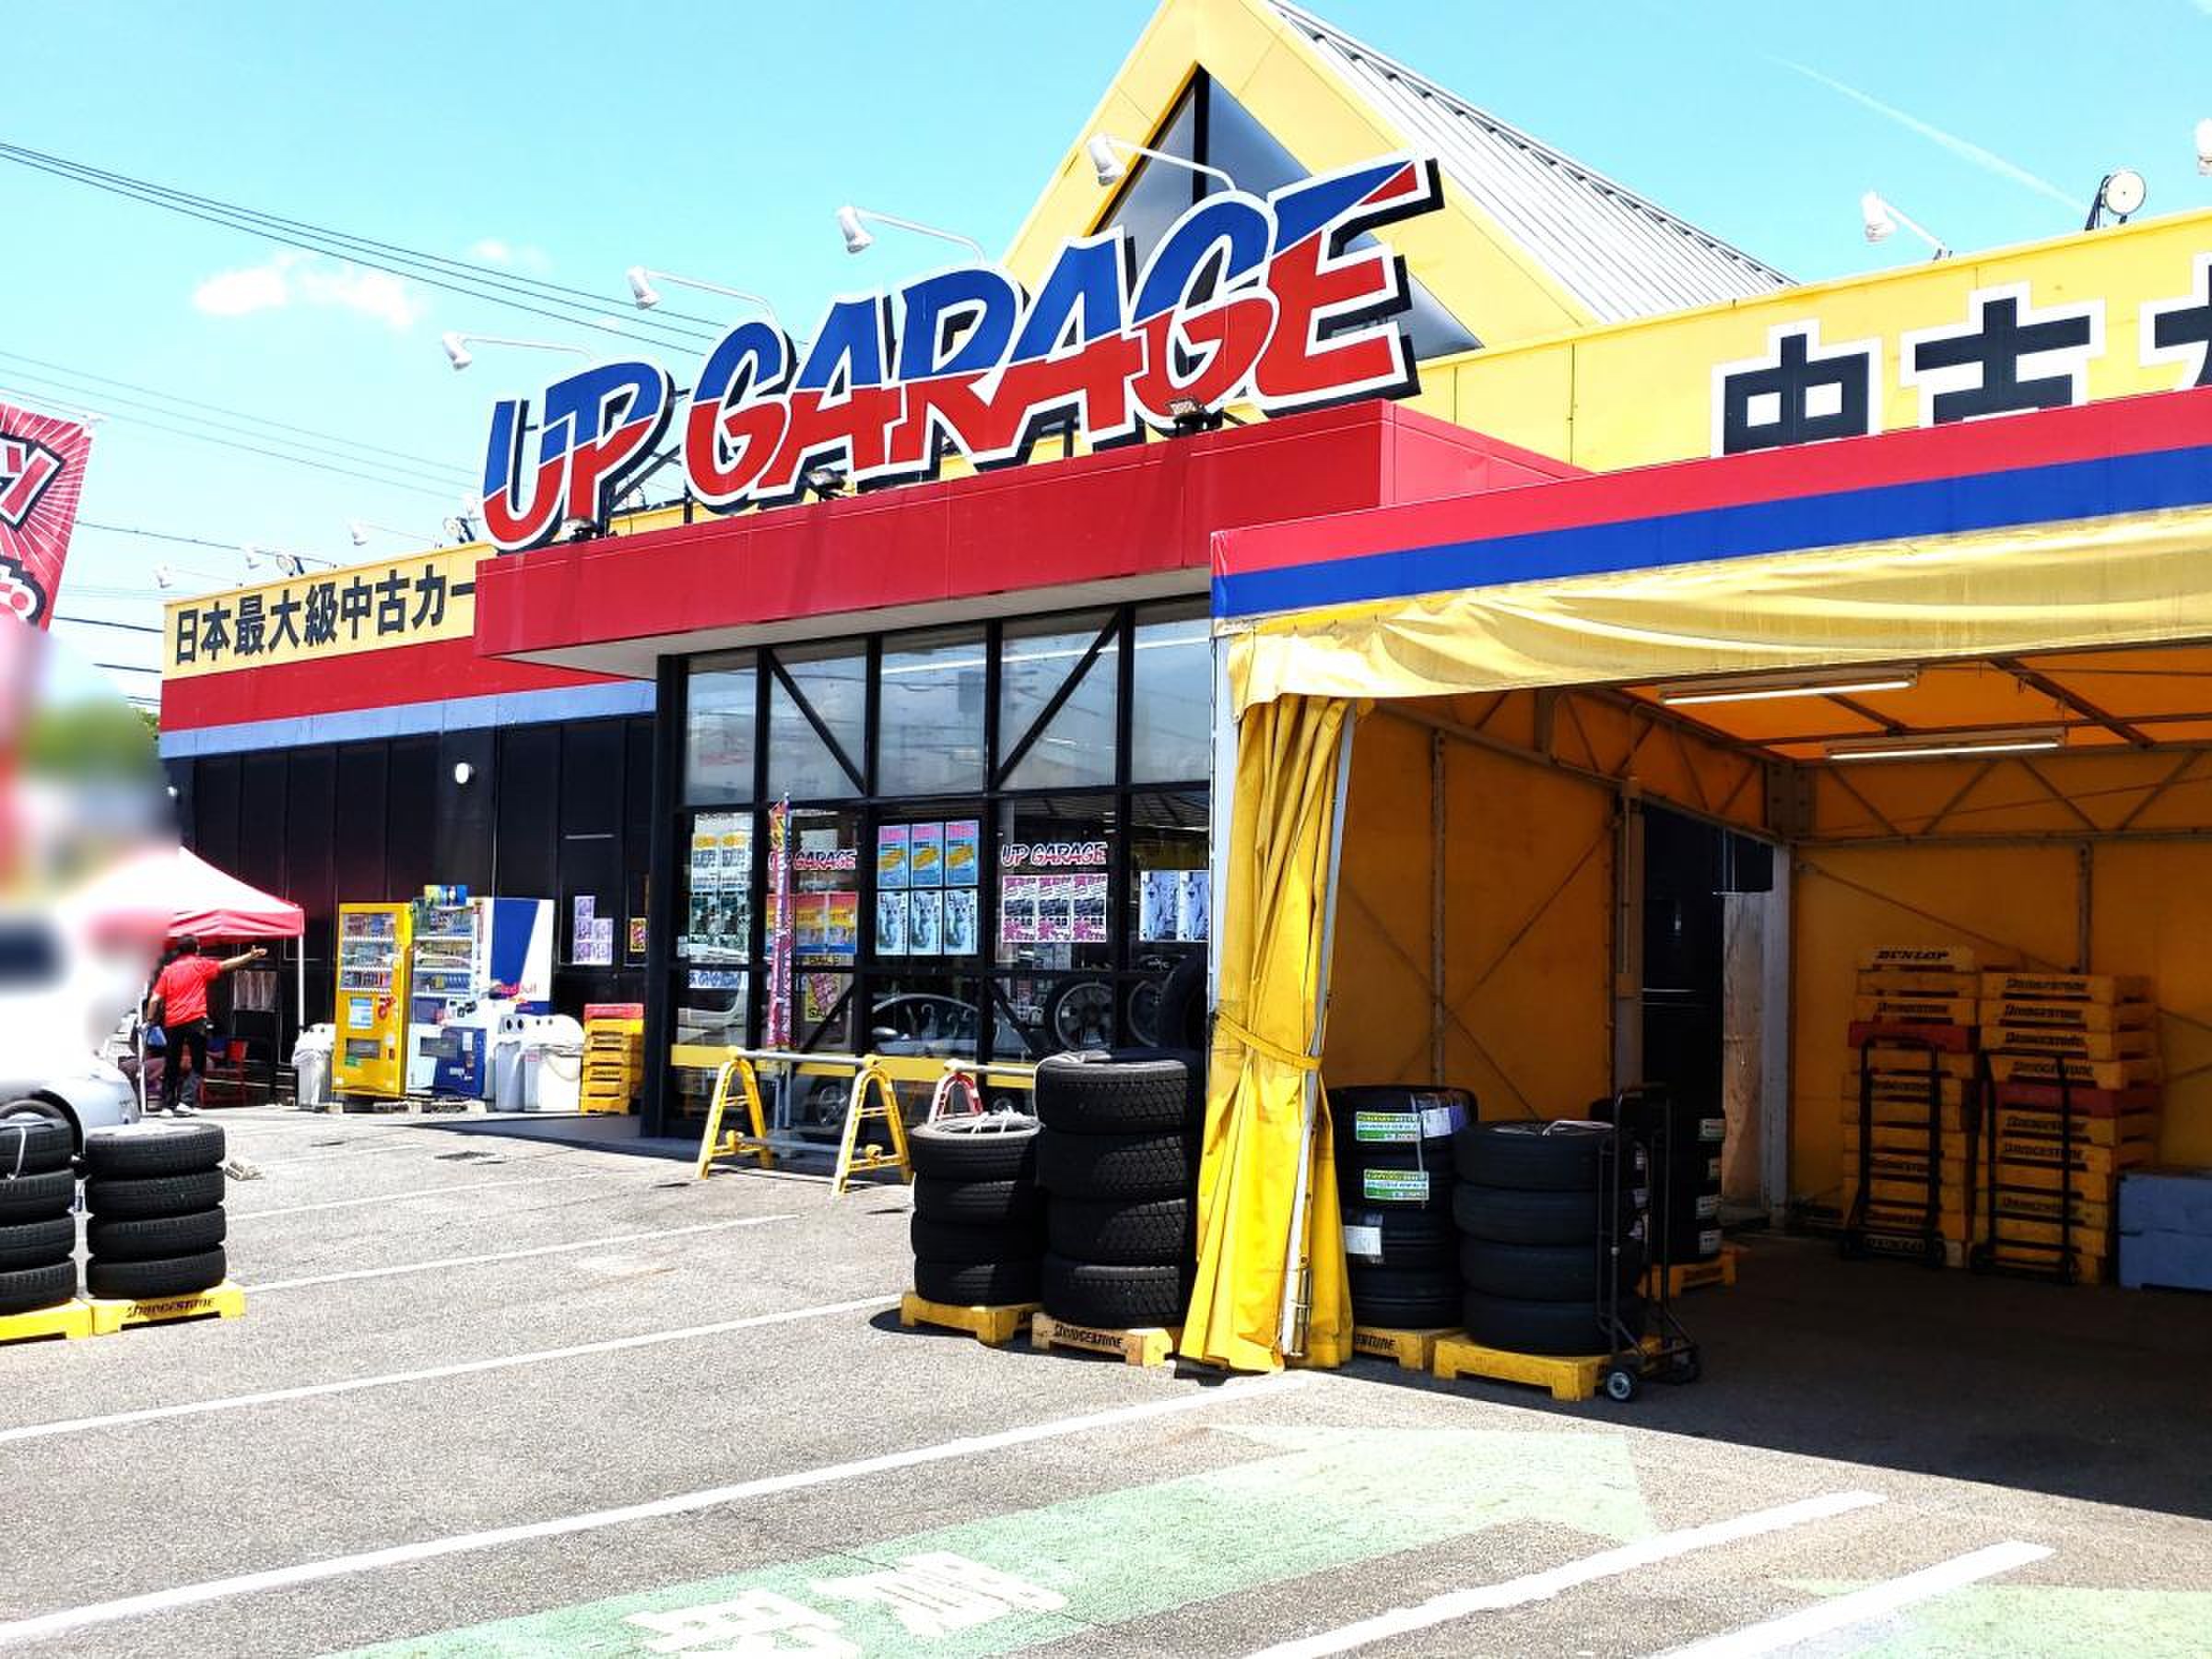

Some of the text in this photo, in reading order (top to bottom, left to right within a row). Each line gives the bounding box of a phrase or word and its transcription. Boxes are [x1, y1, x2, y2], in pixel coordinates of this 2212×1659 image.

[482, 151, 1436, 551] UP GARAGE
[1002, 843, 1030, 867] UP
[1030, 841, 1108, 866] GARAGE
[1877, 950, 1948, 959] DUNLOP
